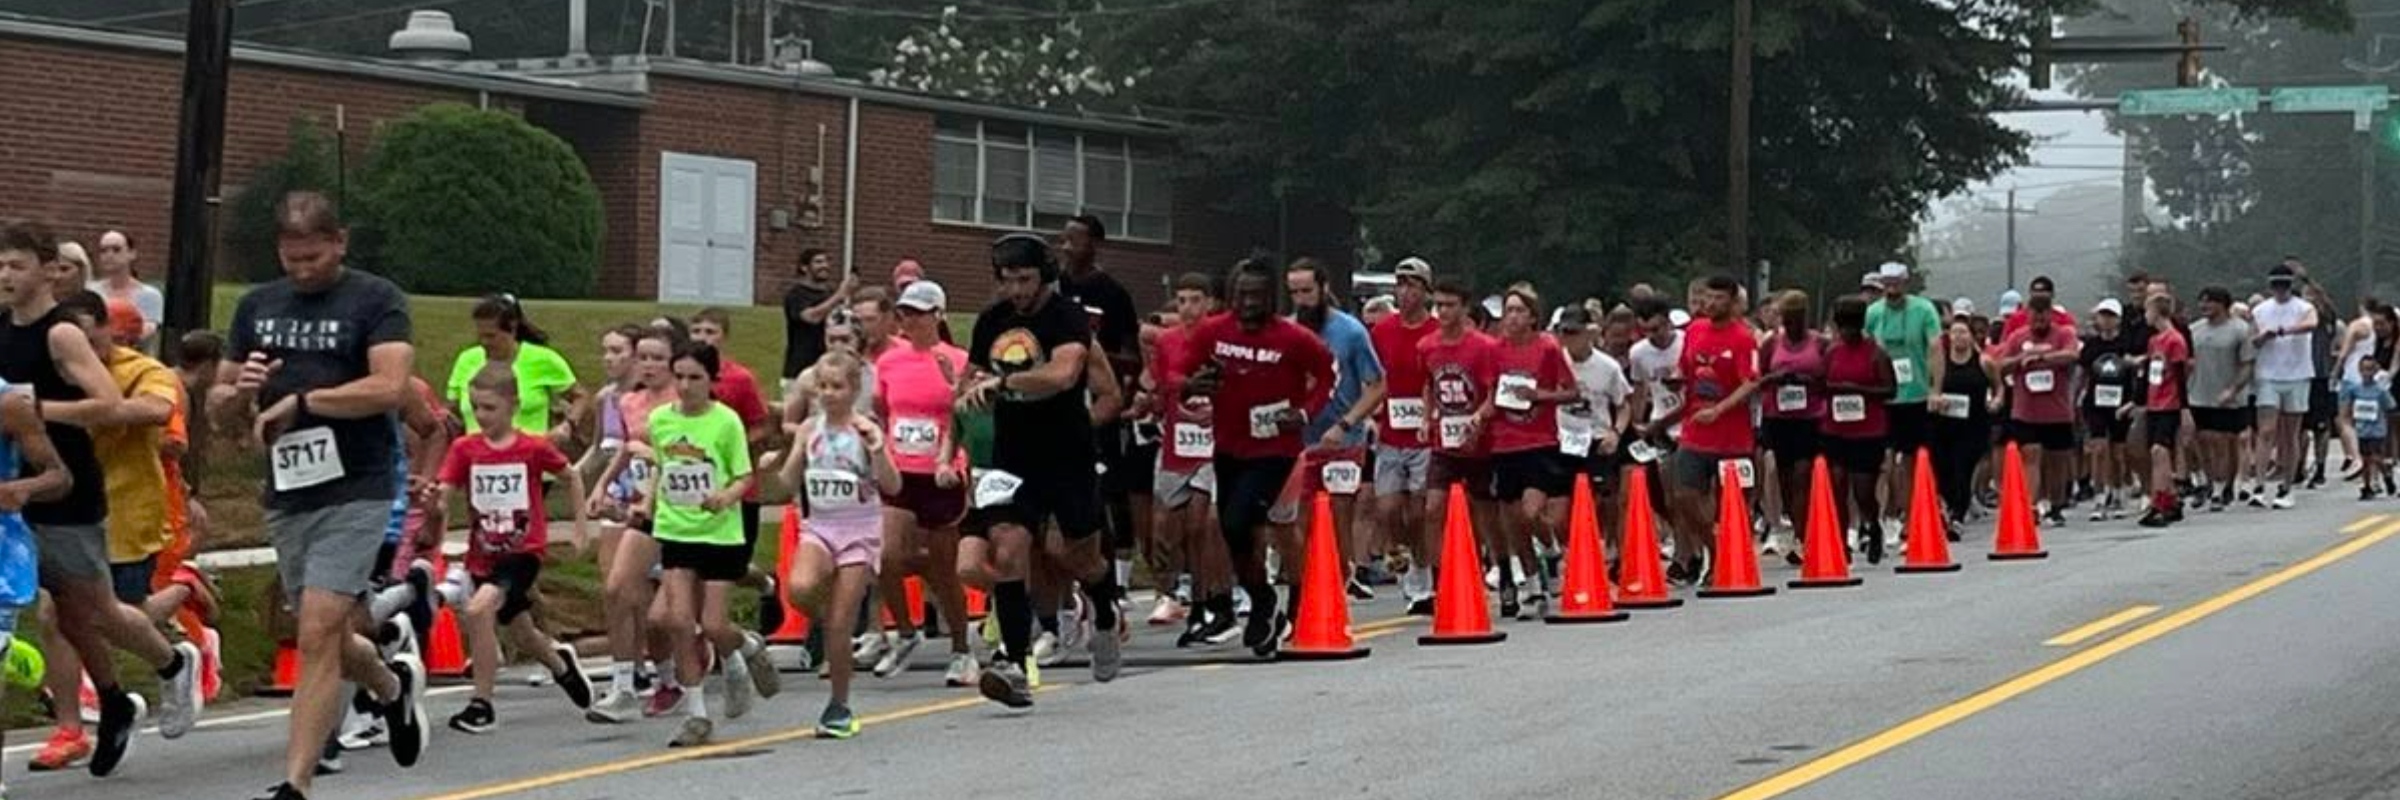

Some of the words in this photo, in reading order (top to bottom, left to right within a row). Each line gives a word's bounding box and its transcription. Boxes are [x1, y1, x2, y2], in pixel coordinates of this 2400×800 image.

[277, 438, 328, 470] 3717
[475, 474, 523, 494] 3737
[668, 472, 711, 492] 3311
[809, 478, 853, 497] 3770
